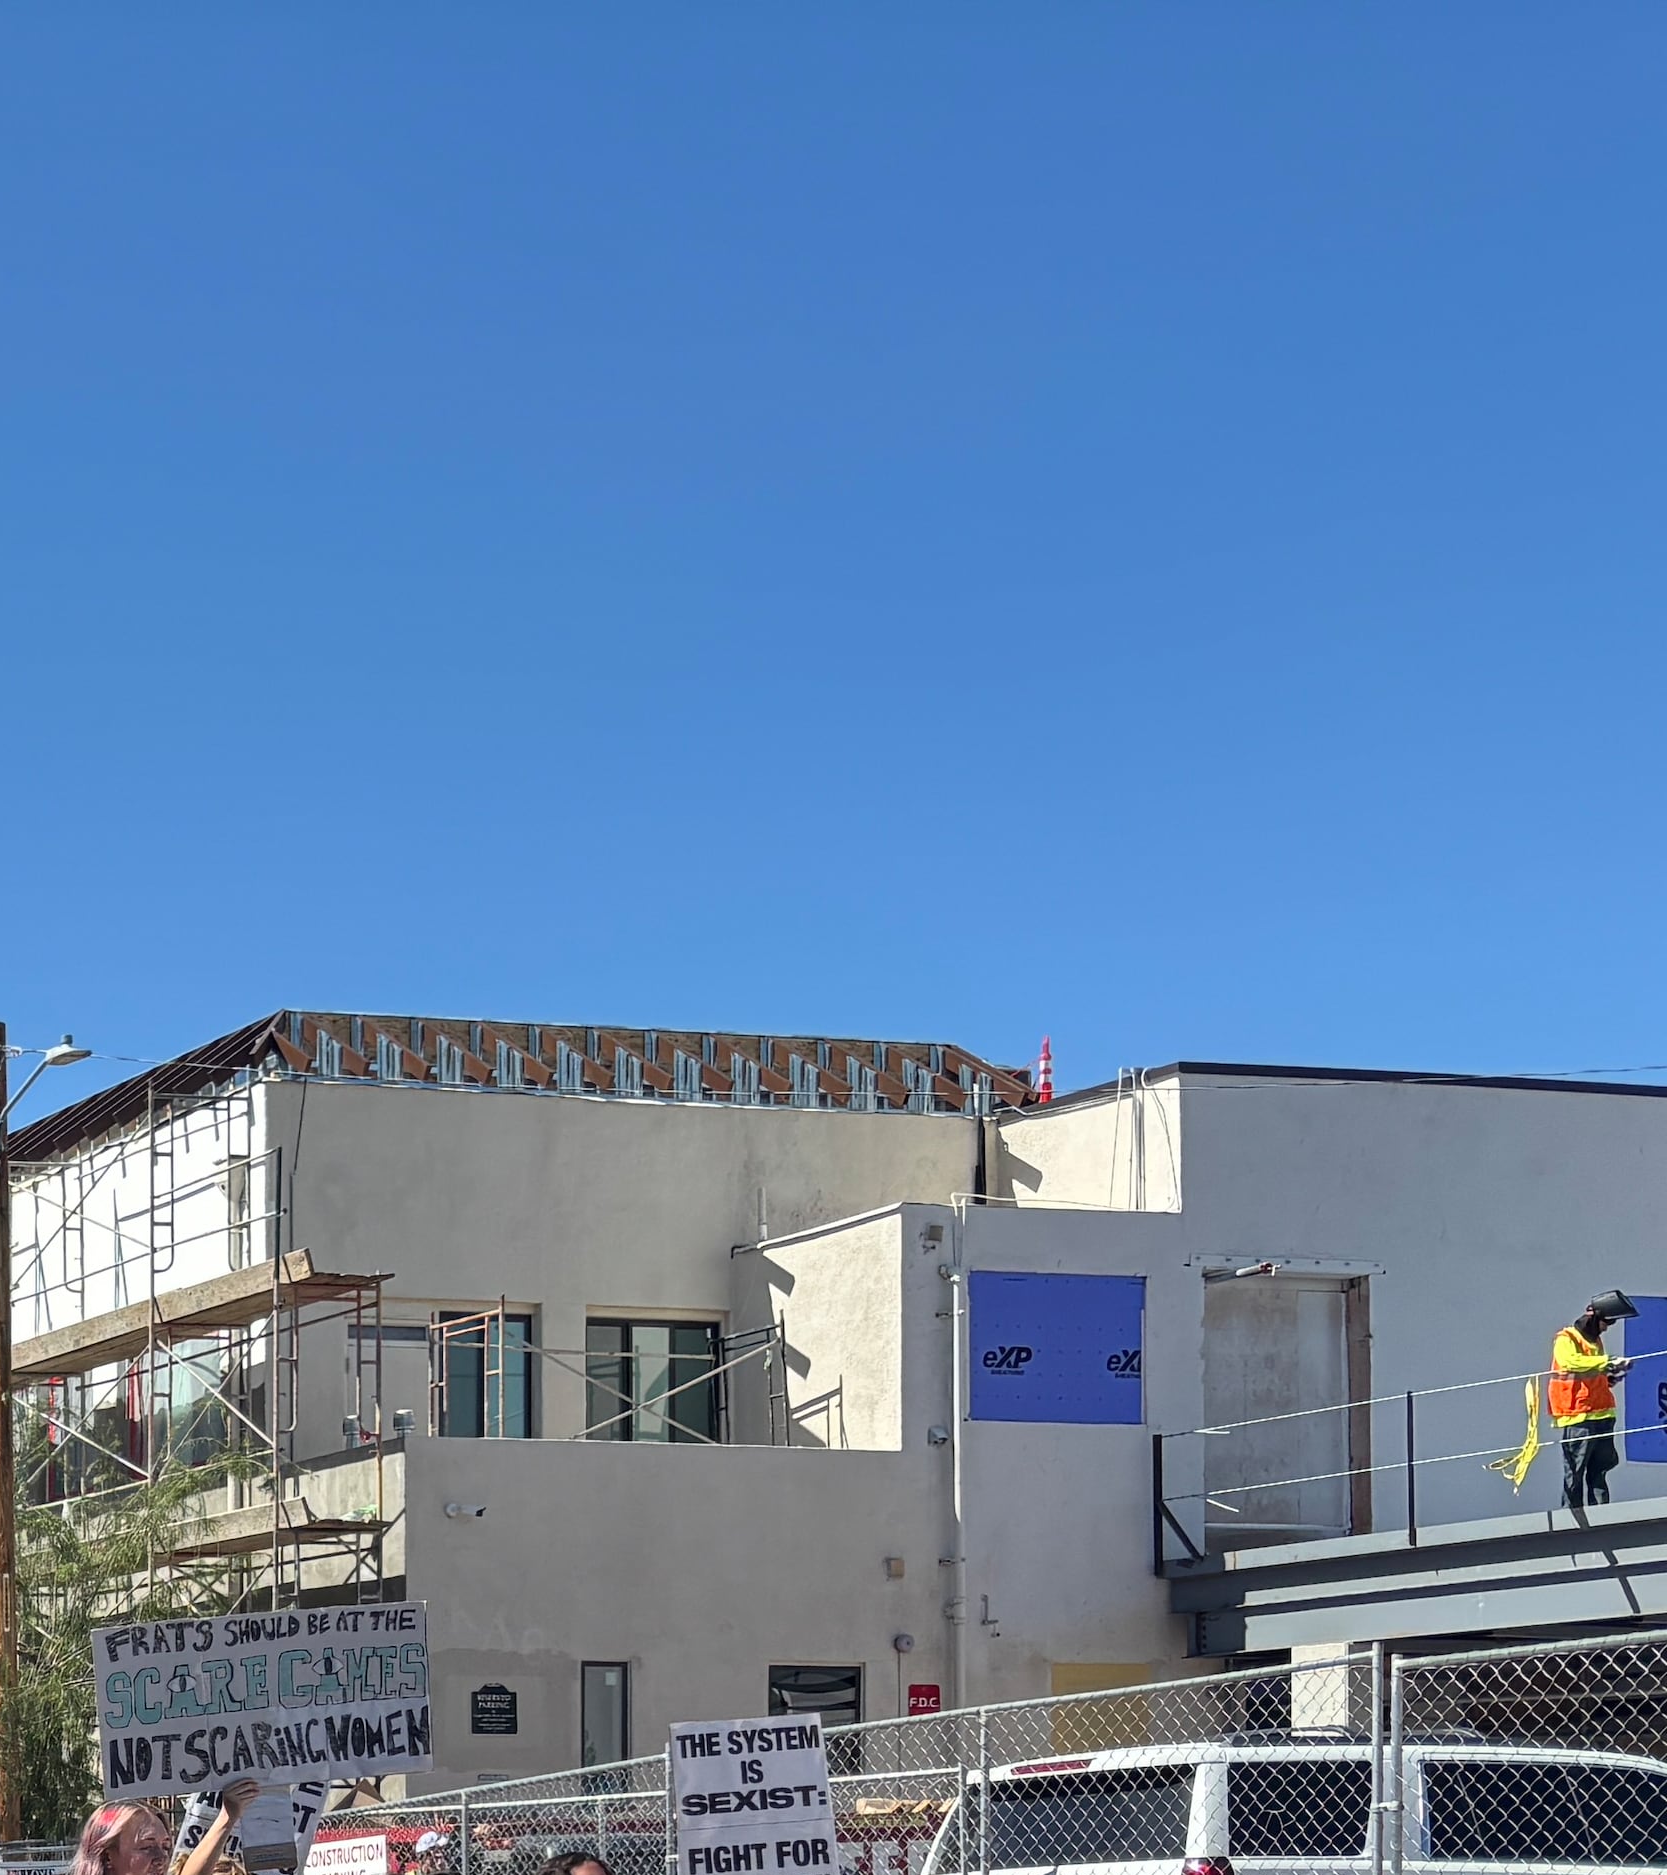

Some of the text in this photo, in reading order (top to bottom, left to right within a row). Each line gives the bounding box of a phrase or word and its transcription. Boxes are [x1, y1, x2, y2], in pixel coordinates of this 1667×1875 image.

[983, 1346, 1032, 1368] eXP
[105, 1609, 416, 1662] FRATS SHOULD BE AT THE
[105, 1643, 427, 1728] SCARE GAMES
[109, 1733, 181, 1788] NOT
[325, 1705, 431, 1761] WOMEN
[676, 1725, 819, 1758] THE SYSTEM
[740, 1759, 763, 1784] IS
[682, 1785, 827, 1816] SEXIST:
[688, 1843, 766, 1875] FIGHT
[775, 1838, 830, 1868] FOR
